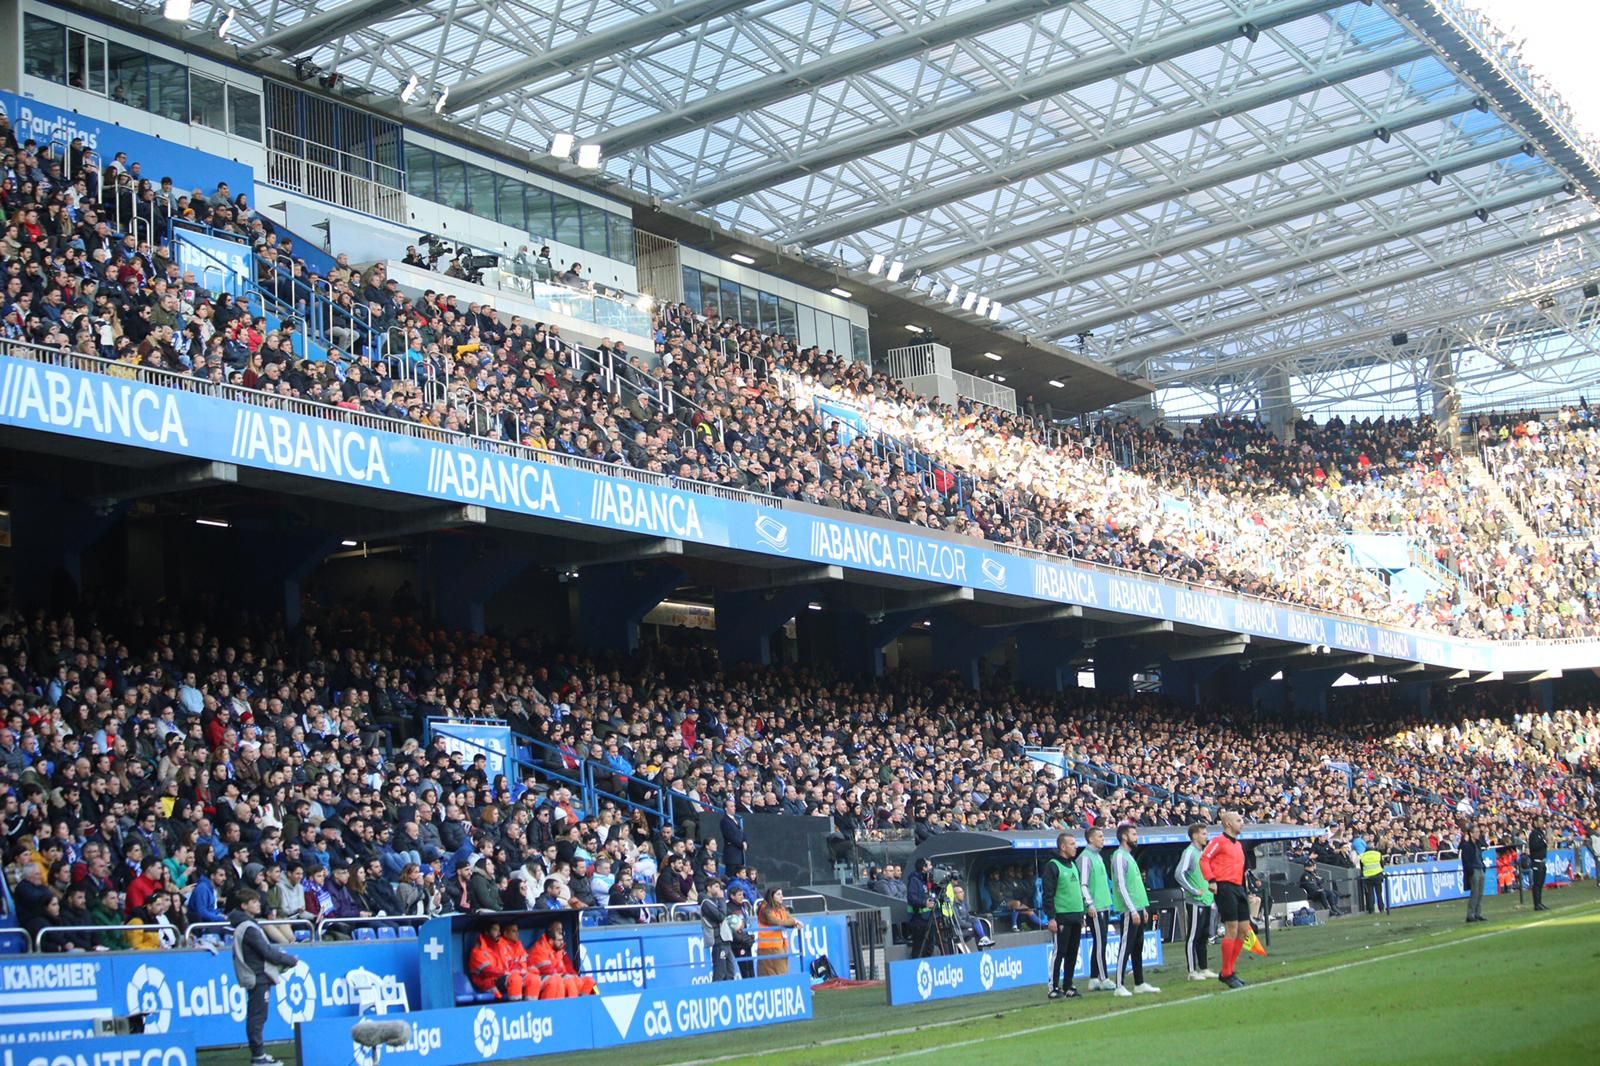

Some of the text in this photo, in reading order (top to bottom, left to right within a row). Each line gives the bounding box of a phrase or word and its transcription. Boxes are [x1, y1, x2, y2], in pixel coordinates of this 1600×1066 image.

[897, 537, 968, 582] RIAZOR
[596, 948, 656, 989] LaLiga
[933, 963, 964, 989] LaLiga
[994, 956, 1023, 977] LaLiga
[176, 973, 246, 1022] LaLig
[677, 996, 732, 1030] GRUPO
[736, 986, 806, 1023] REGUEIRA
[502, 1011, 553, 1043] LaLiga
